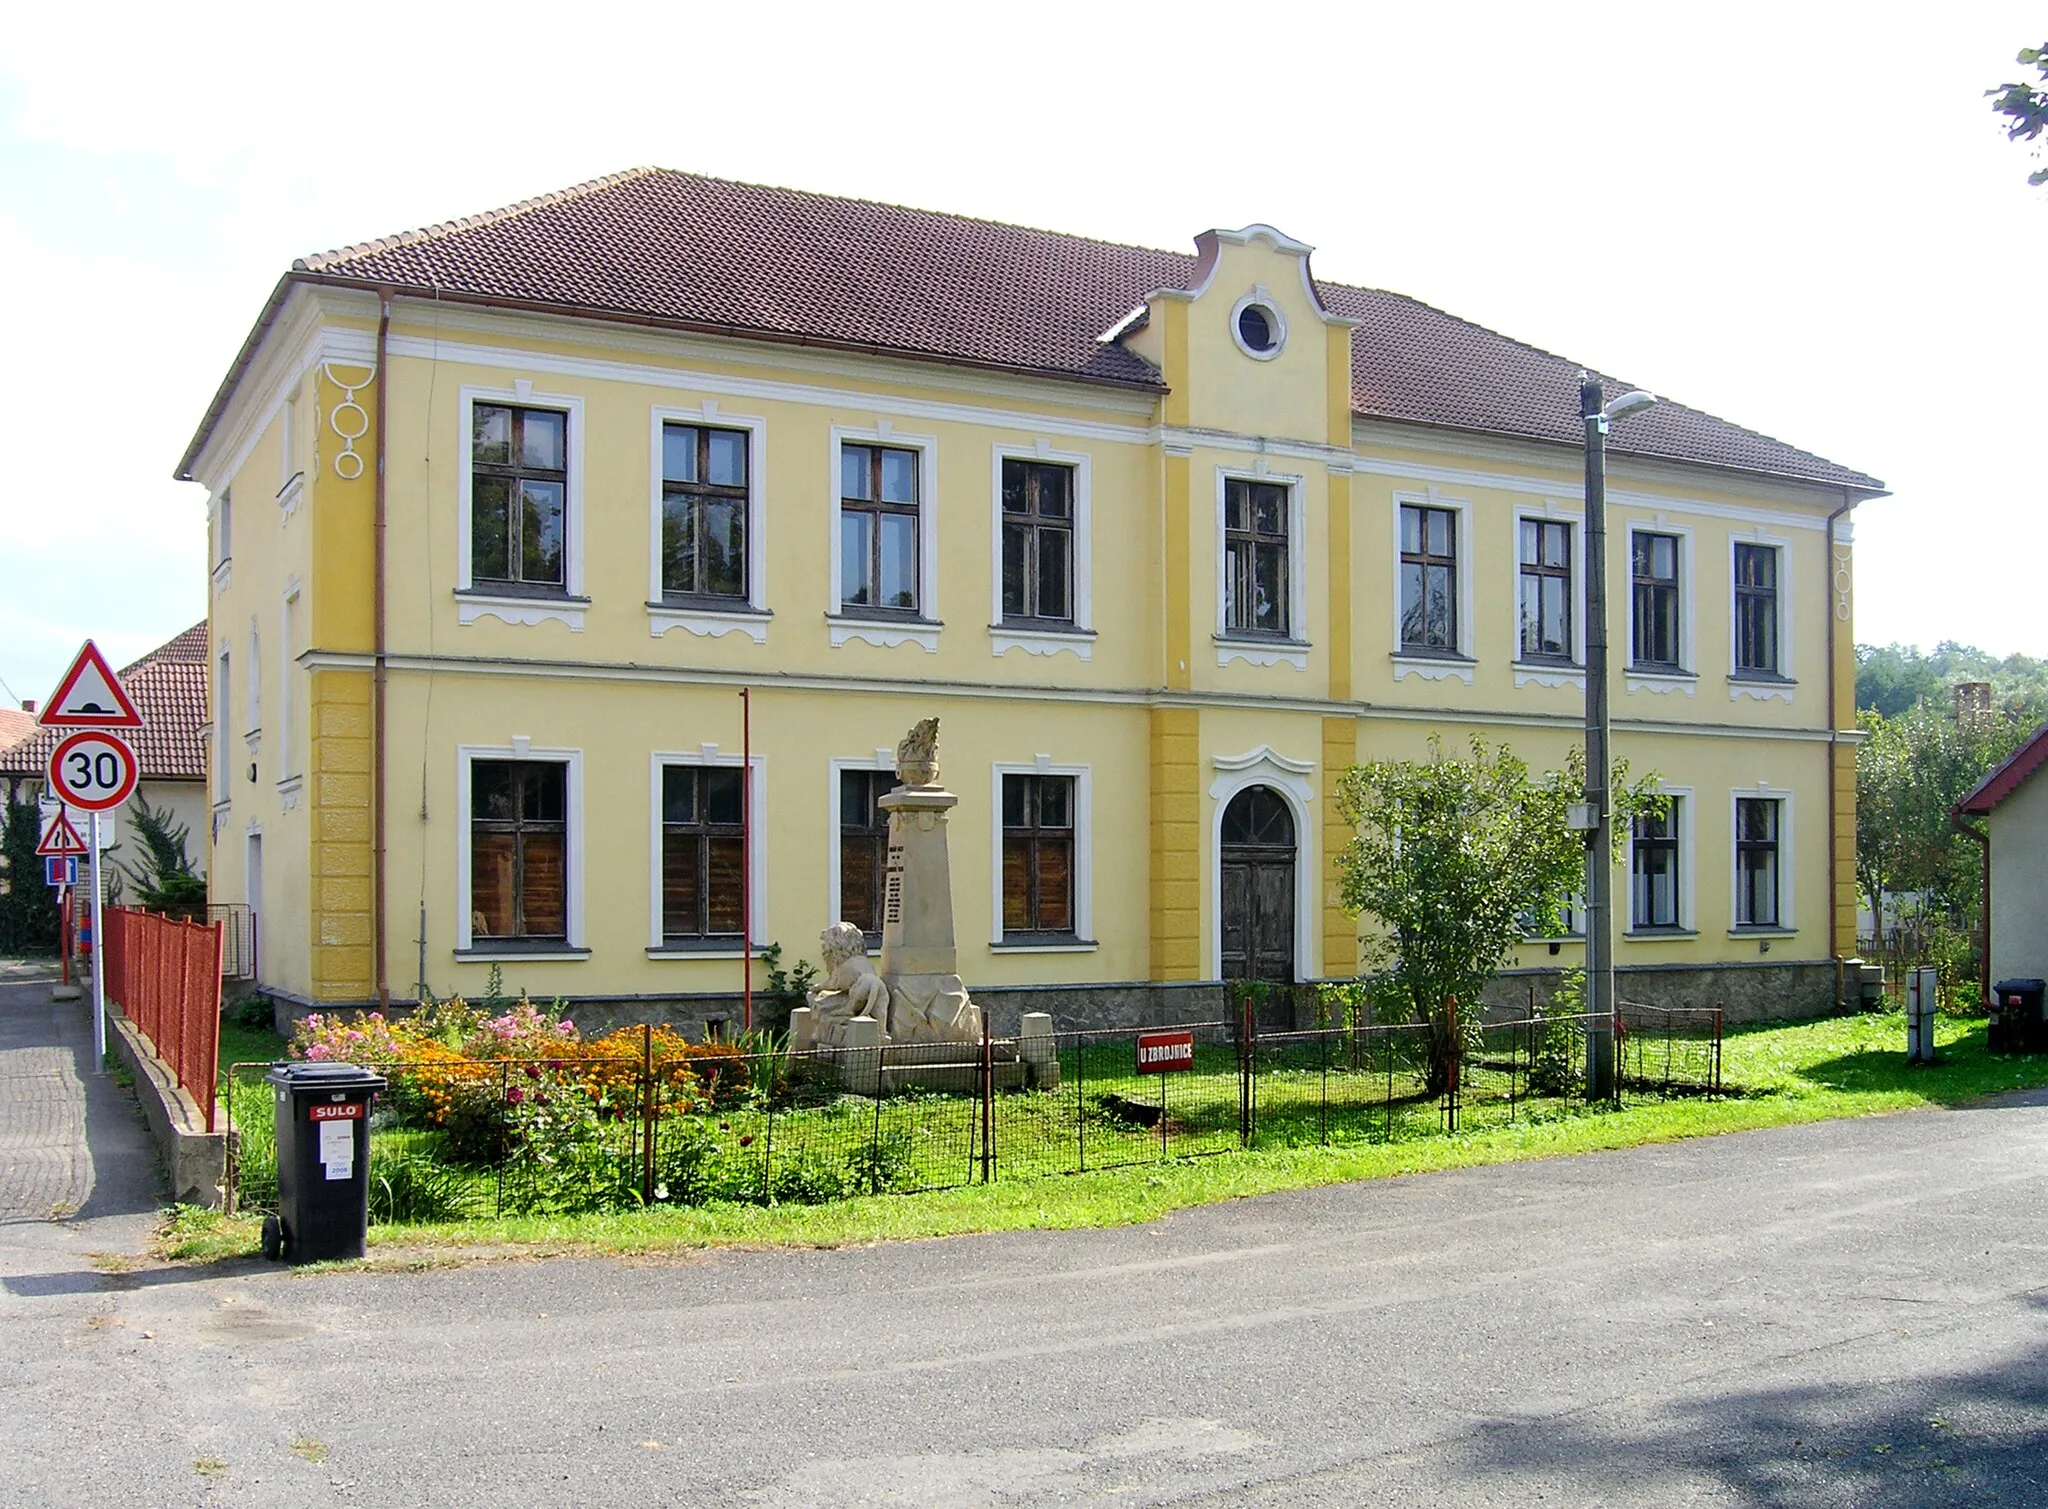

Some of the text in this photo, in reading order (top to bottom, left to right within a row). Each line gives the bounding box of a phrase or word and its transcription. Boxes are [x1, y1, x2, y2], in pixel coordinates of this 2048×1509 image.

[68, 752, 118, 790] 30
[1140, 1043, 1192, 1063] U ZBROJNICE
[316, 1106, 357, 1118] SULO
